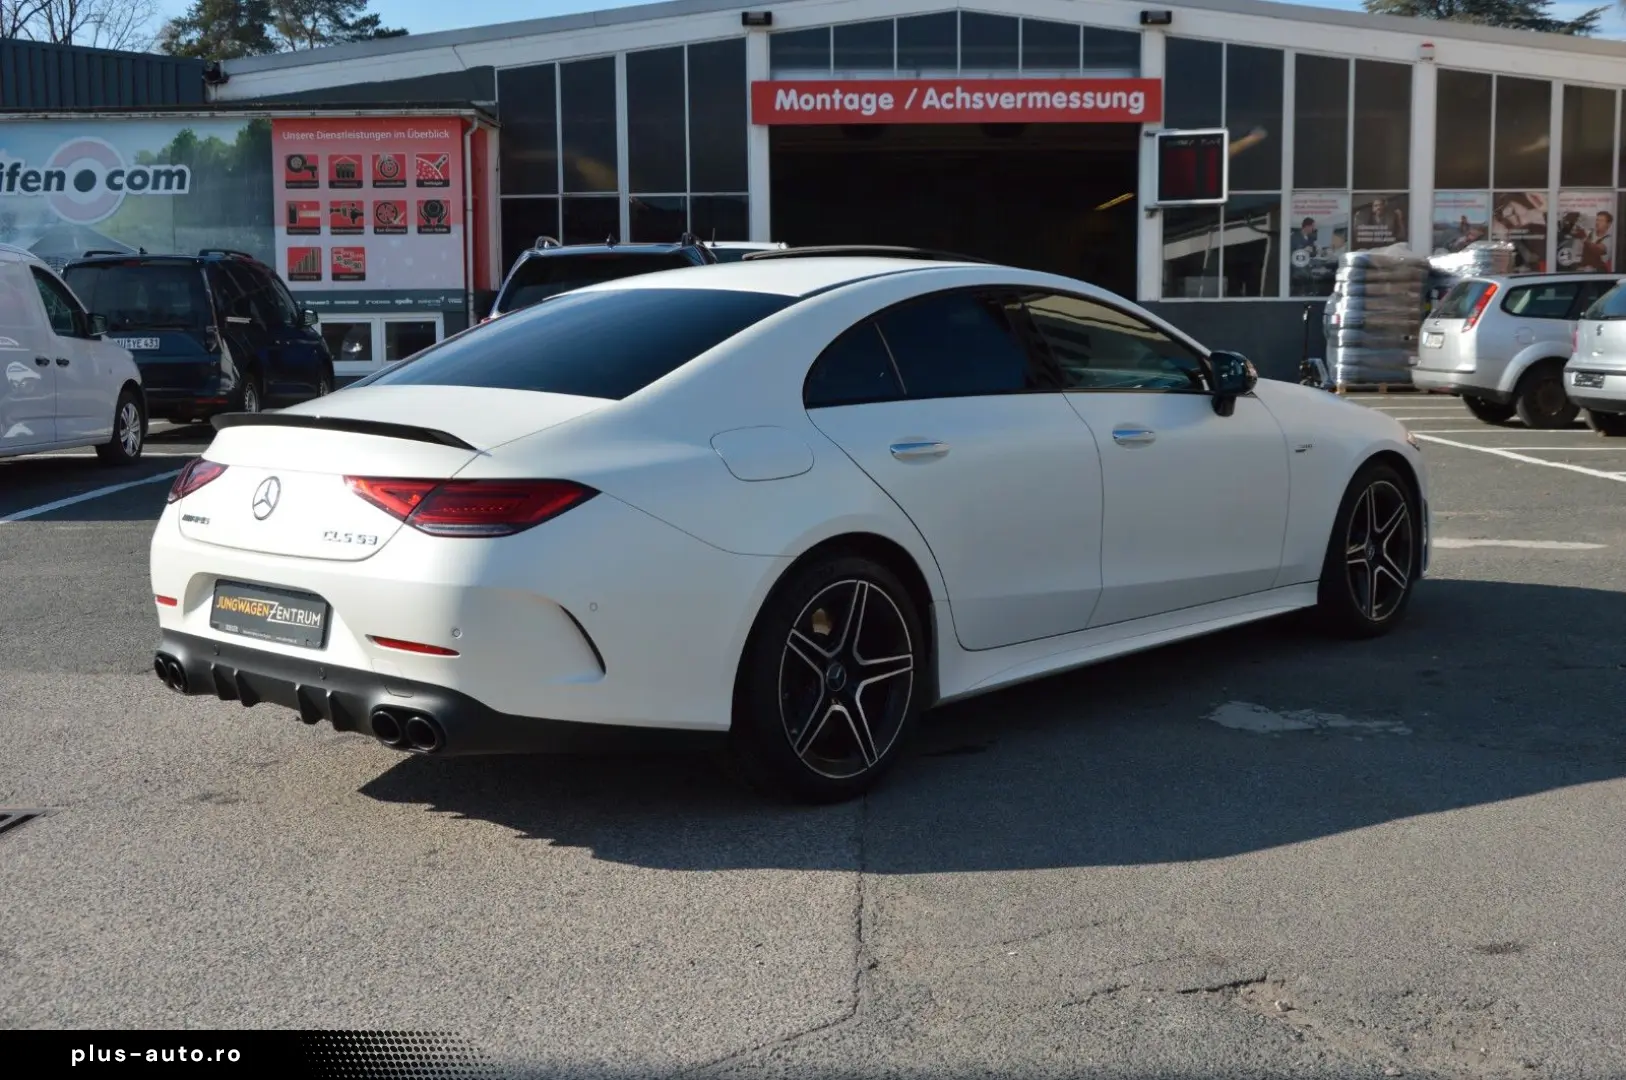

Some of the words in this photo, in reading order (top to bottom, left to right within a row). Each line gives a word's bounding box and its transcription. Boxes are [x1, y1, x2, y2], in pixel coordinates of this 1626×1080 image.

[775, 88, 894, 116] Montage
[922, 86, 1145, 114] Achsvermessung
[282, 131, 314, 141] Unsere
[317, 129, 391, 141] Dienstleistungen
[394, 130, 405, 138] im
[407, 127, 450, 139] Überblick
[324, 531, 352, 543] CLS
[356, 534, 378, 545] 53
